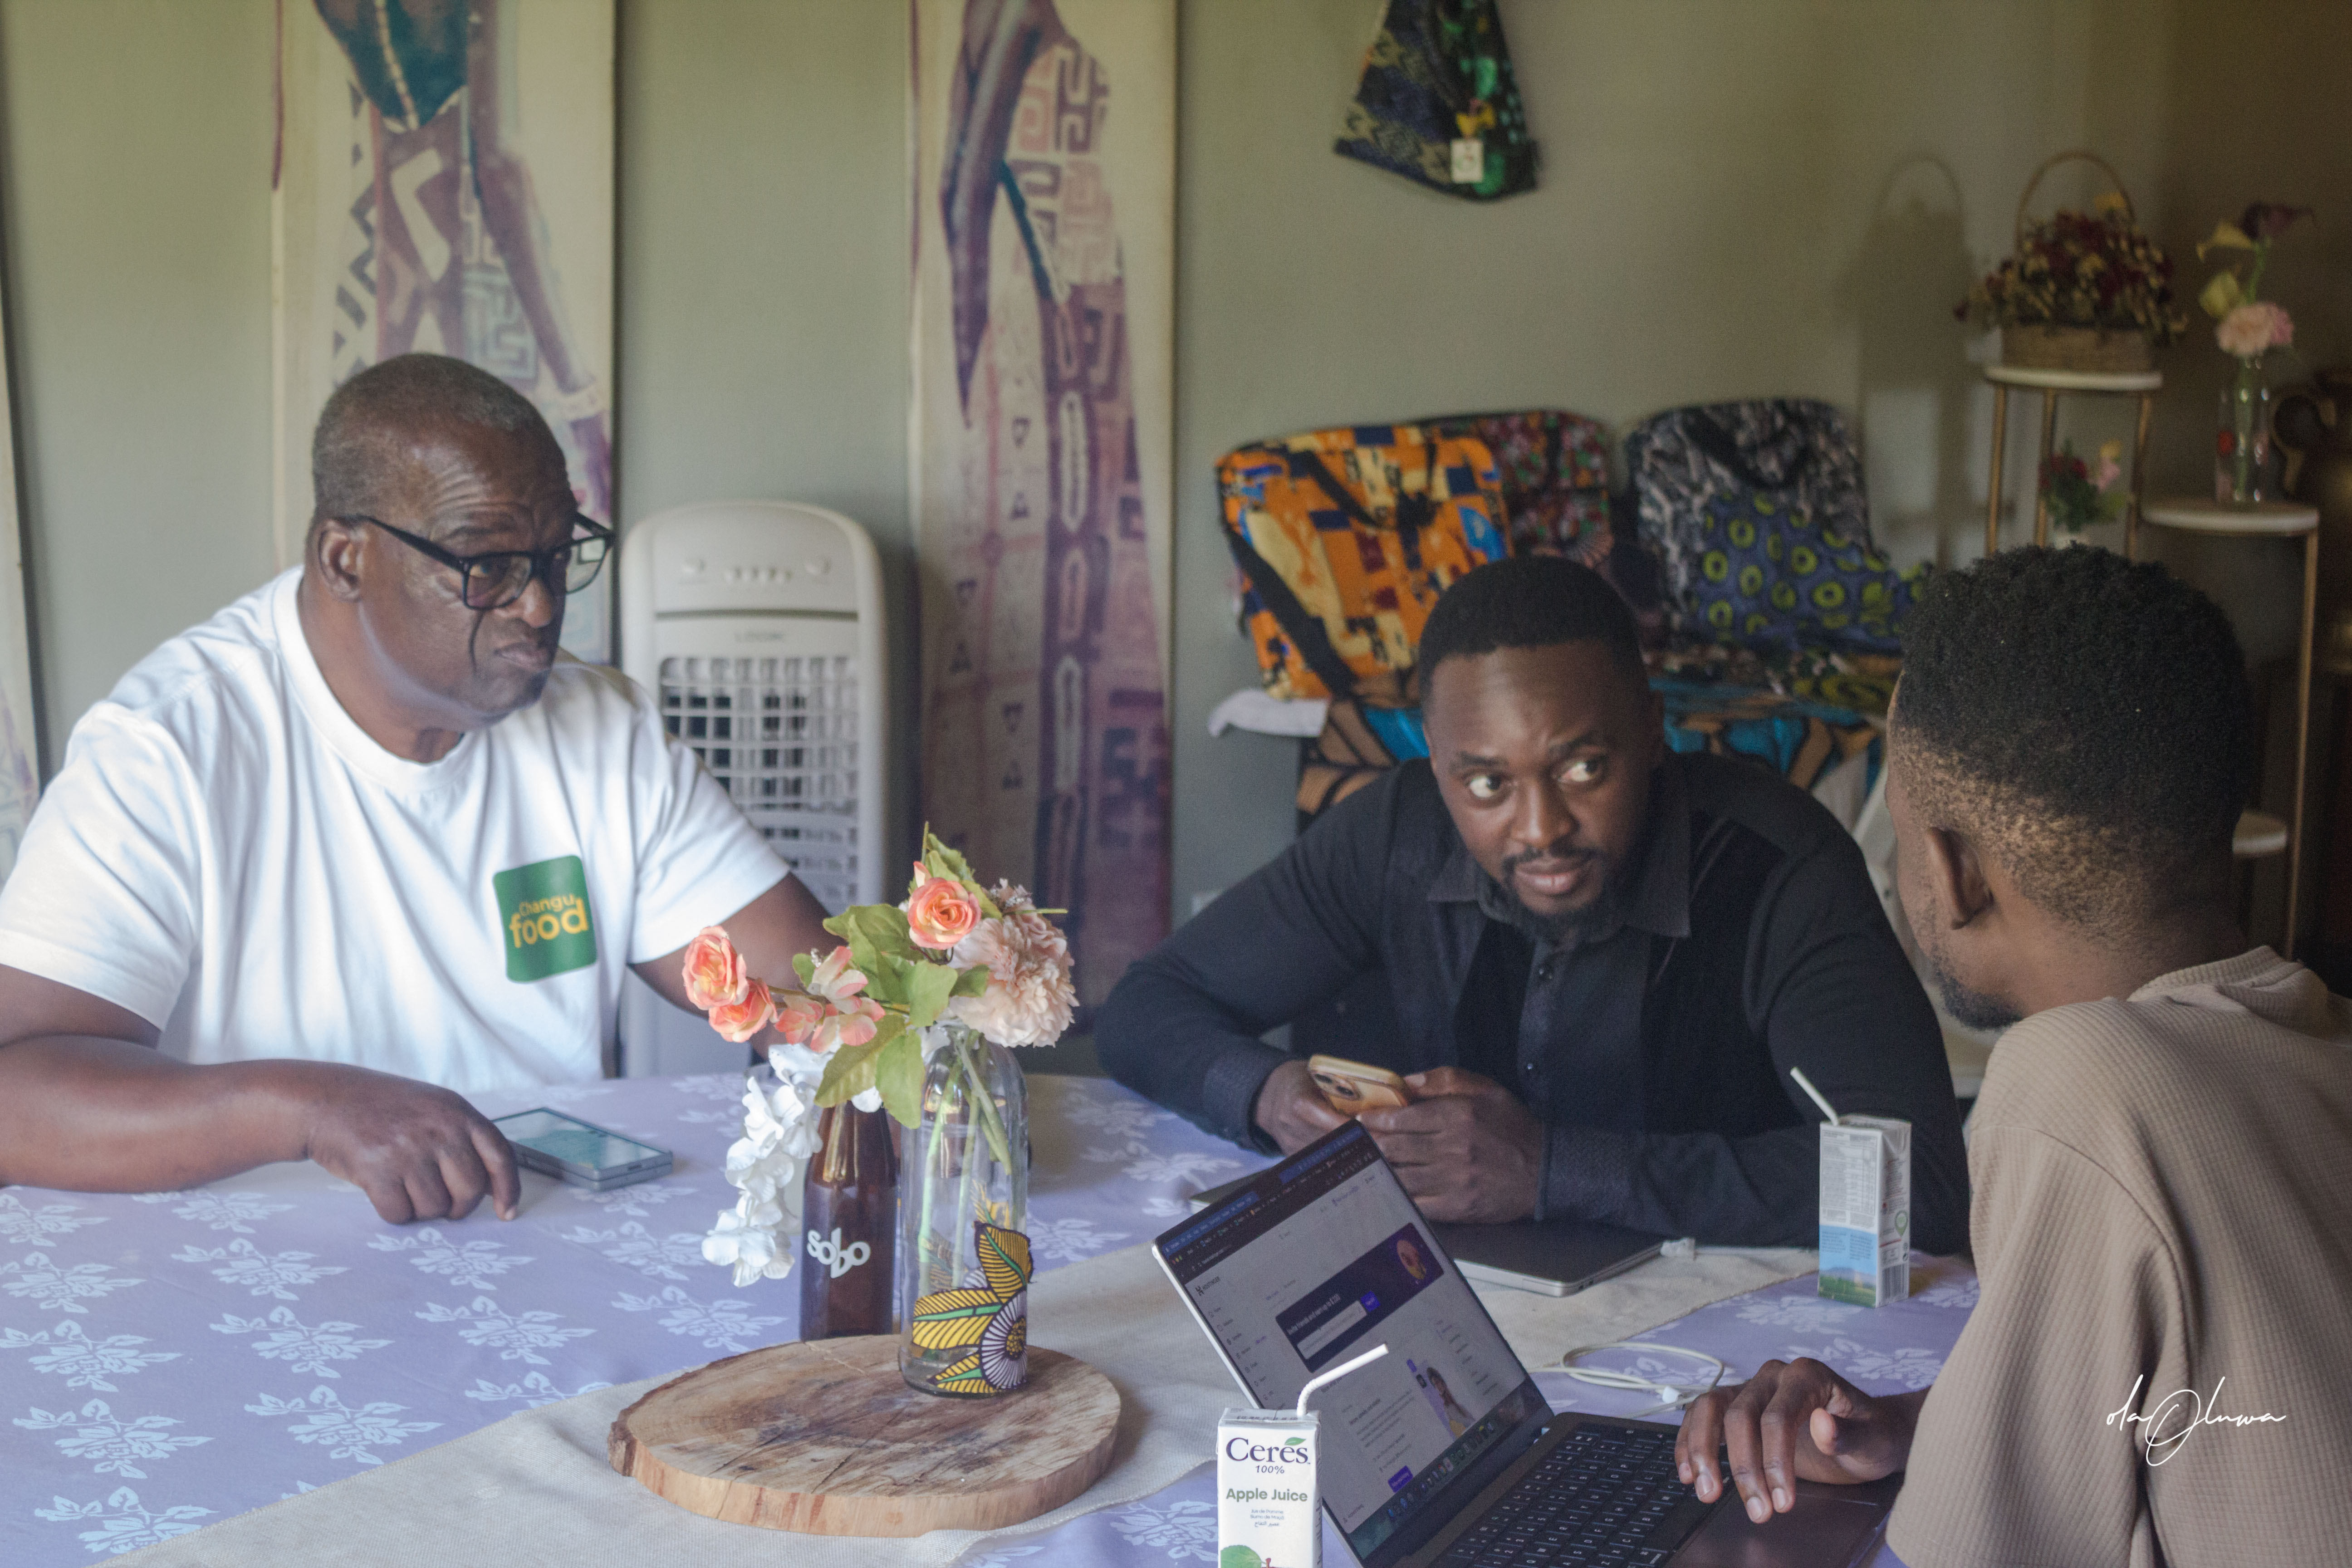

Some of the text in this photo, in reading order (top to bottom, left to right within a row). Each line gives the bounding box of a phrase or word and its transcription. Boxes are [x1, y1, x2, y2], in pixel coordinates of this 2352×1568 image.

[509, 898, 588, 948] food
[807, 1227, 872, 1279] sobo
[1226, 1437, 1308, 1464] Ceres
[1255, 1465, 1284, 1474] 100%
[1226, 1488, 1308, 1502] Apple Juice
